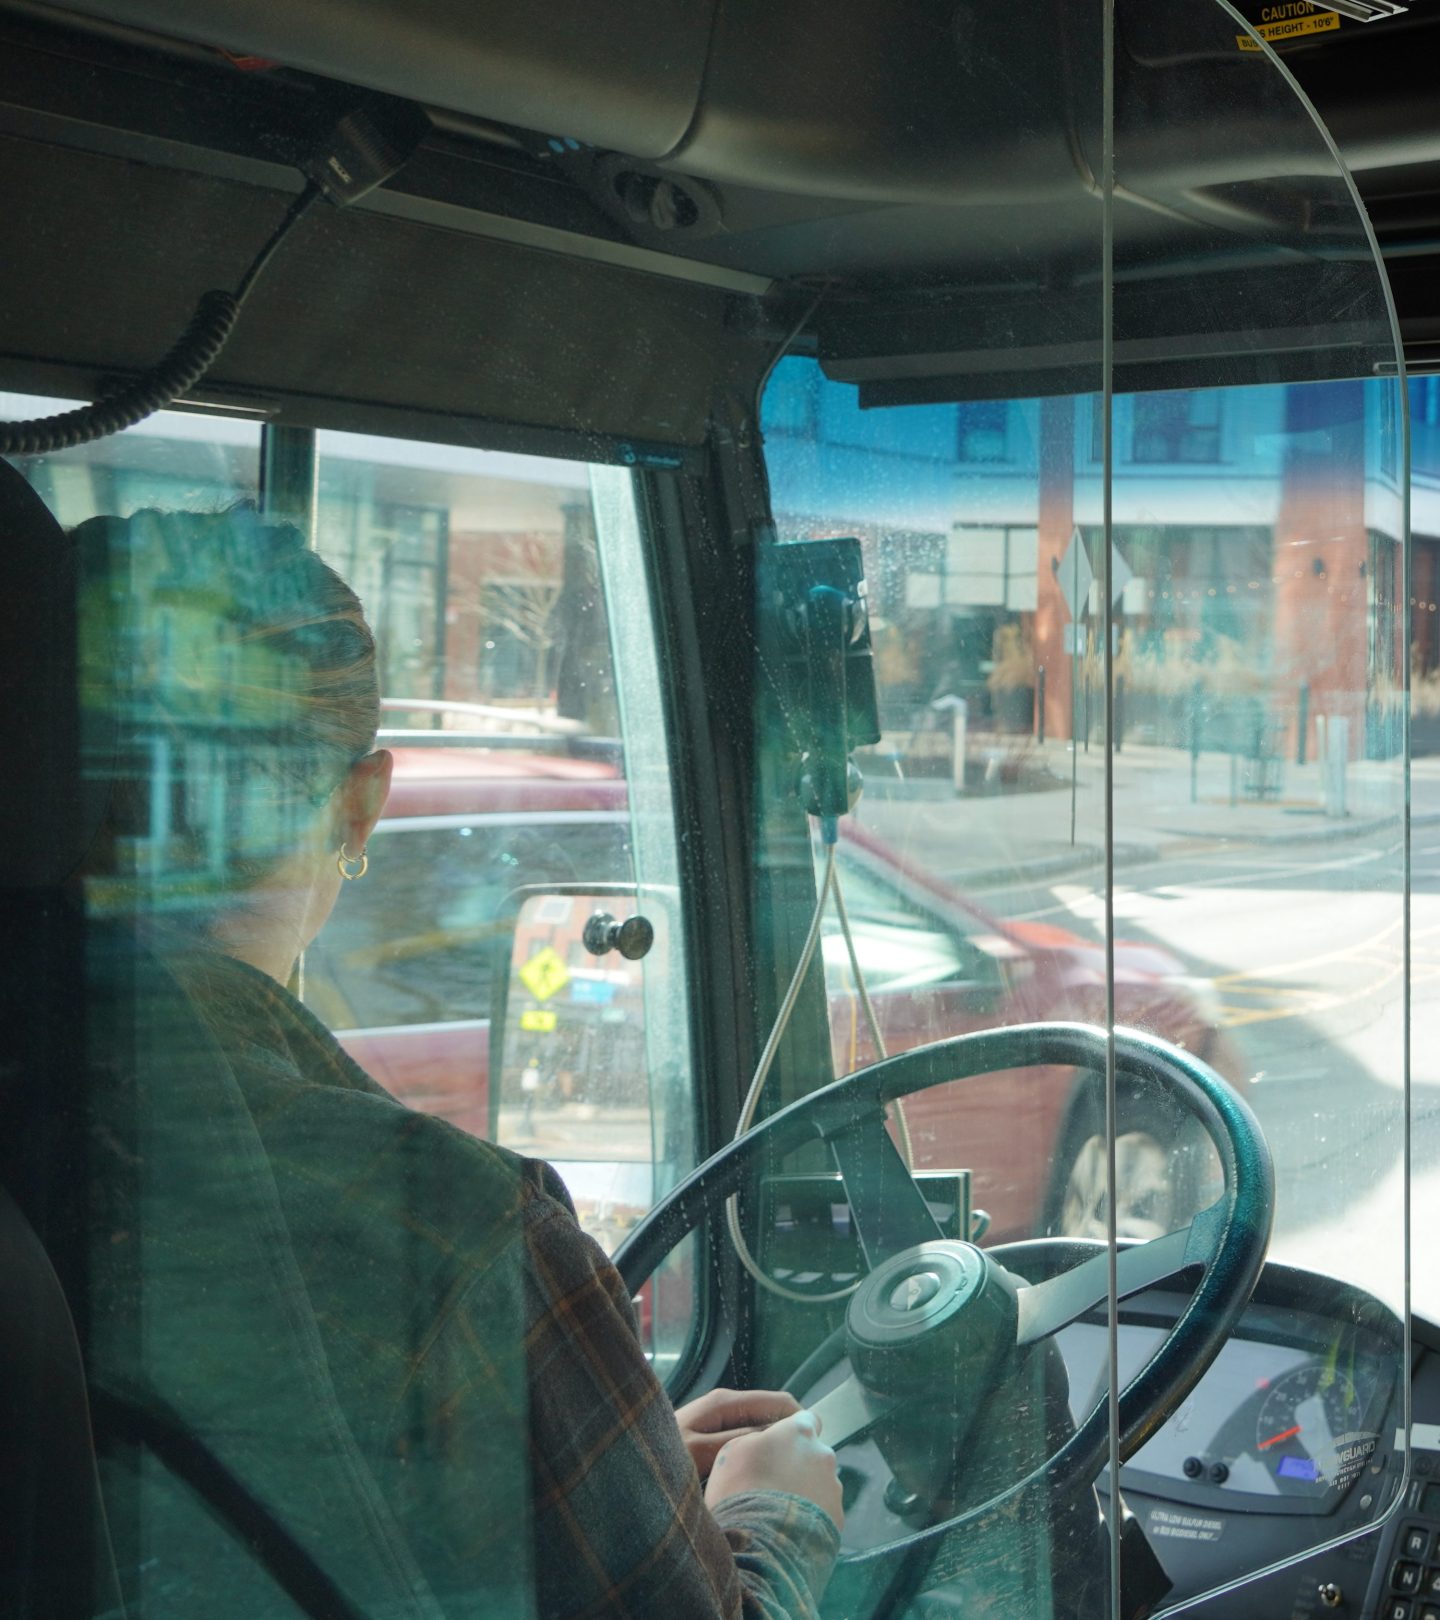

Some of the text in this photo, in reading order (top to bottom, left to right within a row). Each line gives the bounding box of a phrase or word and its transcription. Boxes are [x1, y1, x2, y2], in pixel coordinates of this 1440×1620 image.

[1261, 2, 1314, 21] CAUTION
[1268, 22, 1304, 37] HEIGHT
[1411, 1536, 1422, 1550] R
[1402, 1571, 1414, 1585] N
[1393, 1606, 1405, 1620] D
